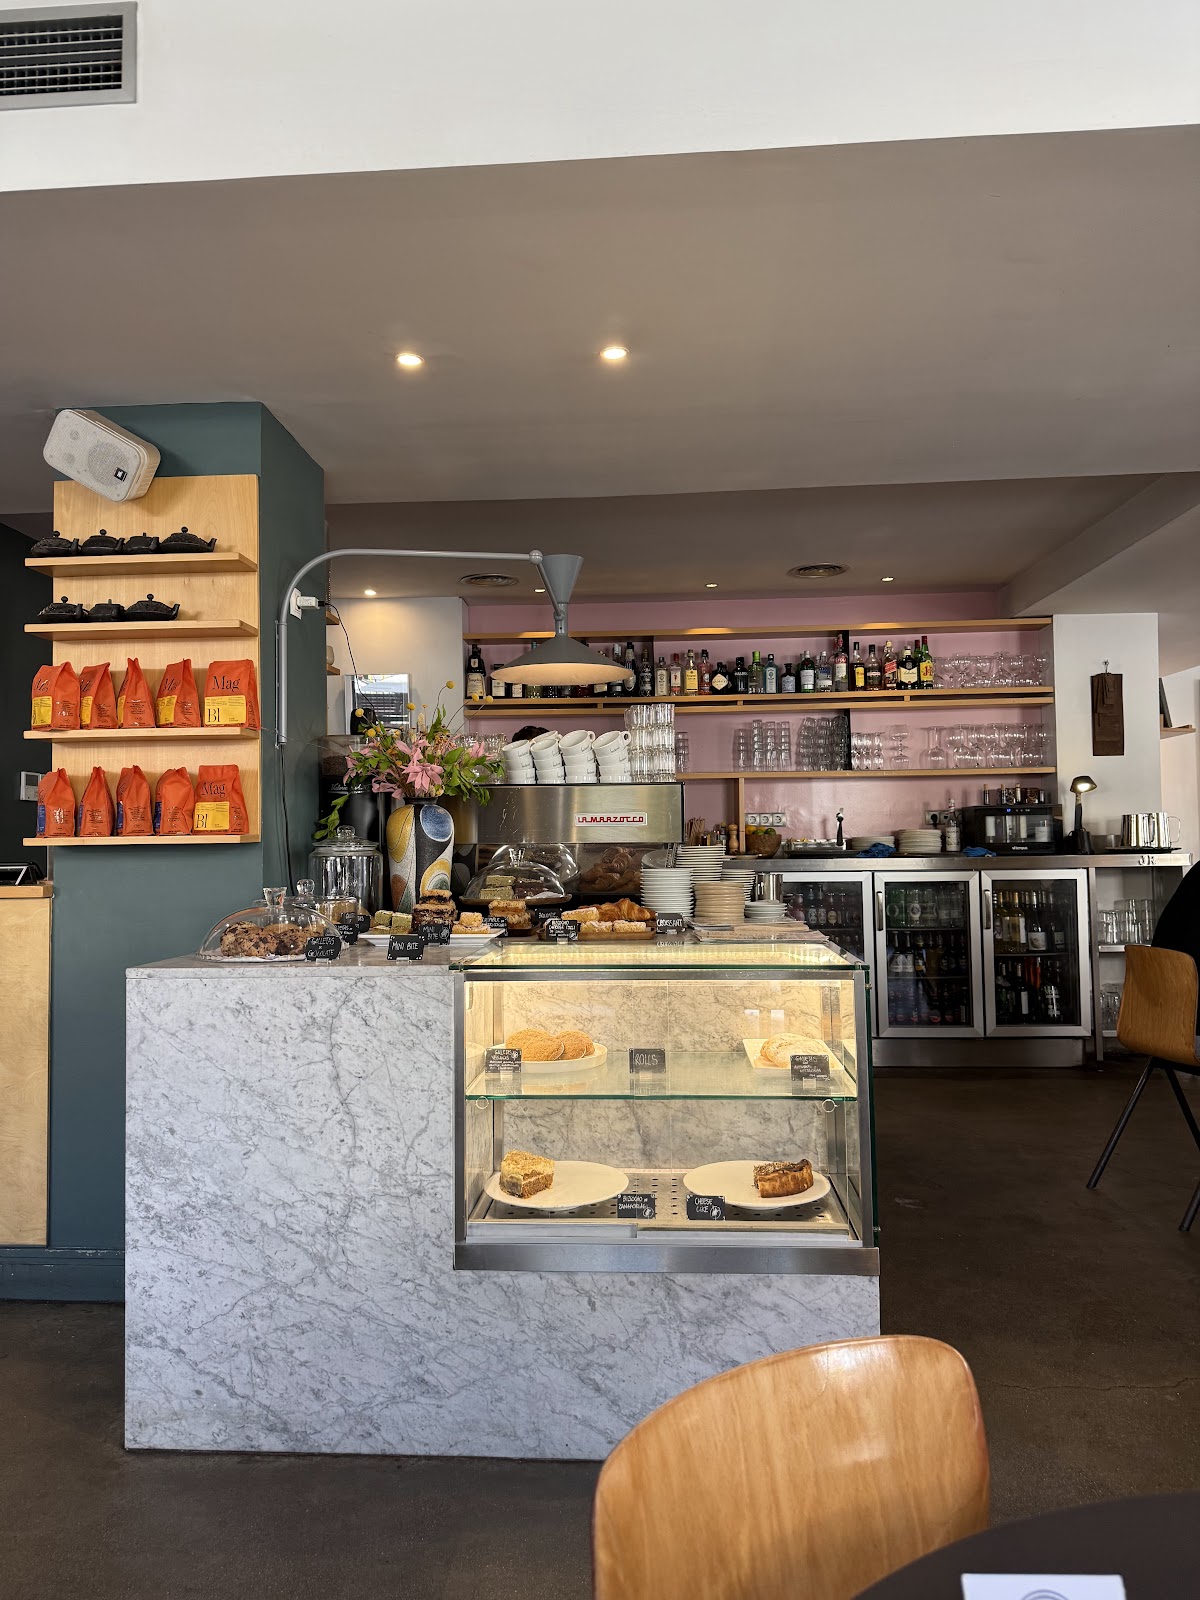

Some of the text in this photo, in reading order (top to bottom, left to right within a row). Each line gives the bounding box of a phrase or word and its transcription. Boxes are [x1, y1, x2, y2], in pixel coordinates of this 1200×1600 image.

[212, 676, 240, 692] Mag
[200, 782, 225, 798] Mag
[656, 919, 683, 927] CROISSANT
[391, 941, 419, 951] MINI BITE
[635, 1053, 659, 1066] ROLLS
